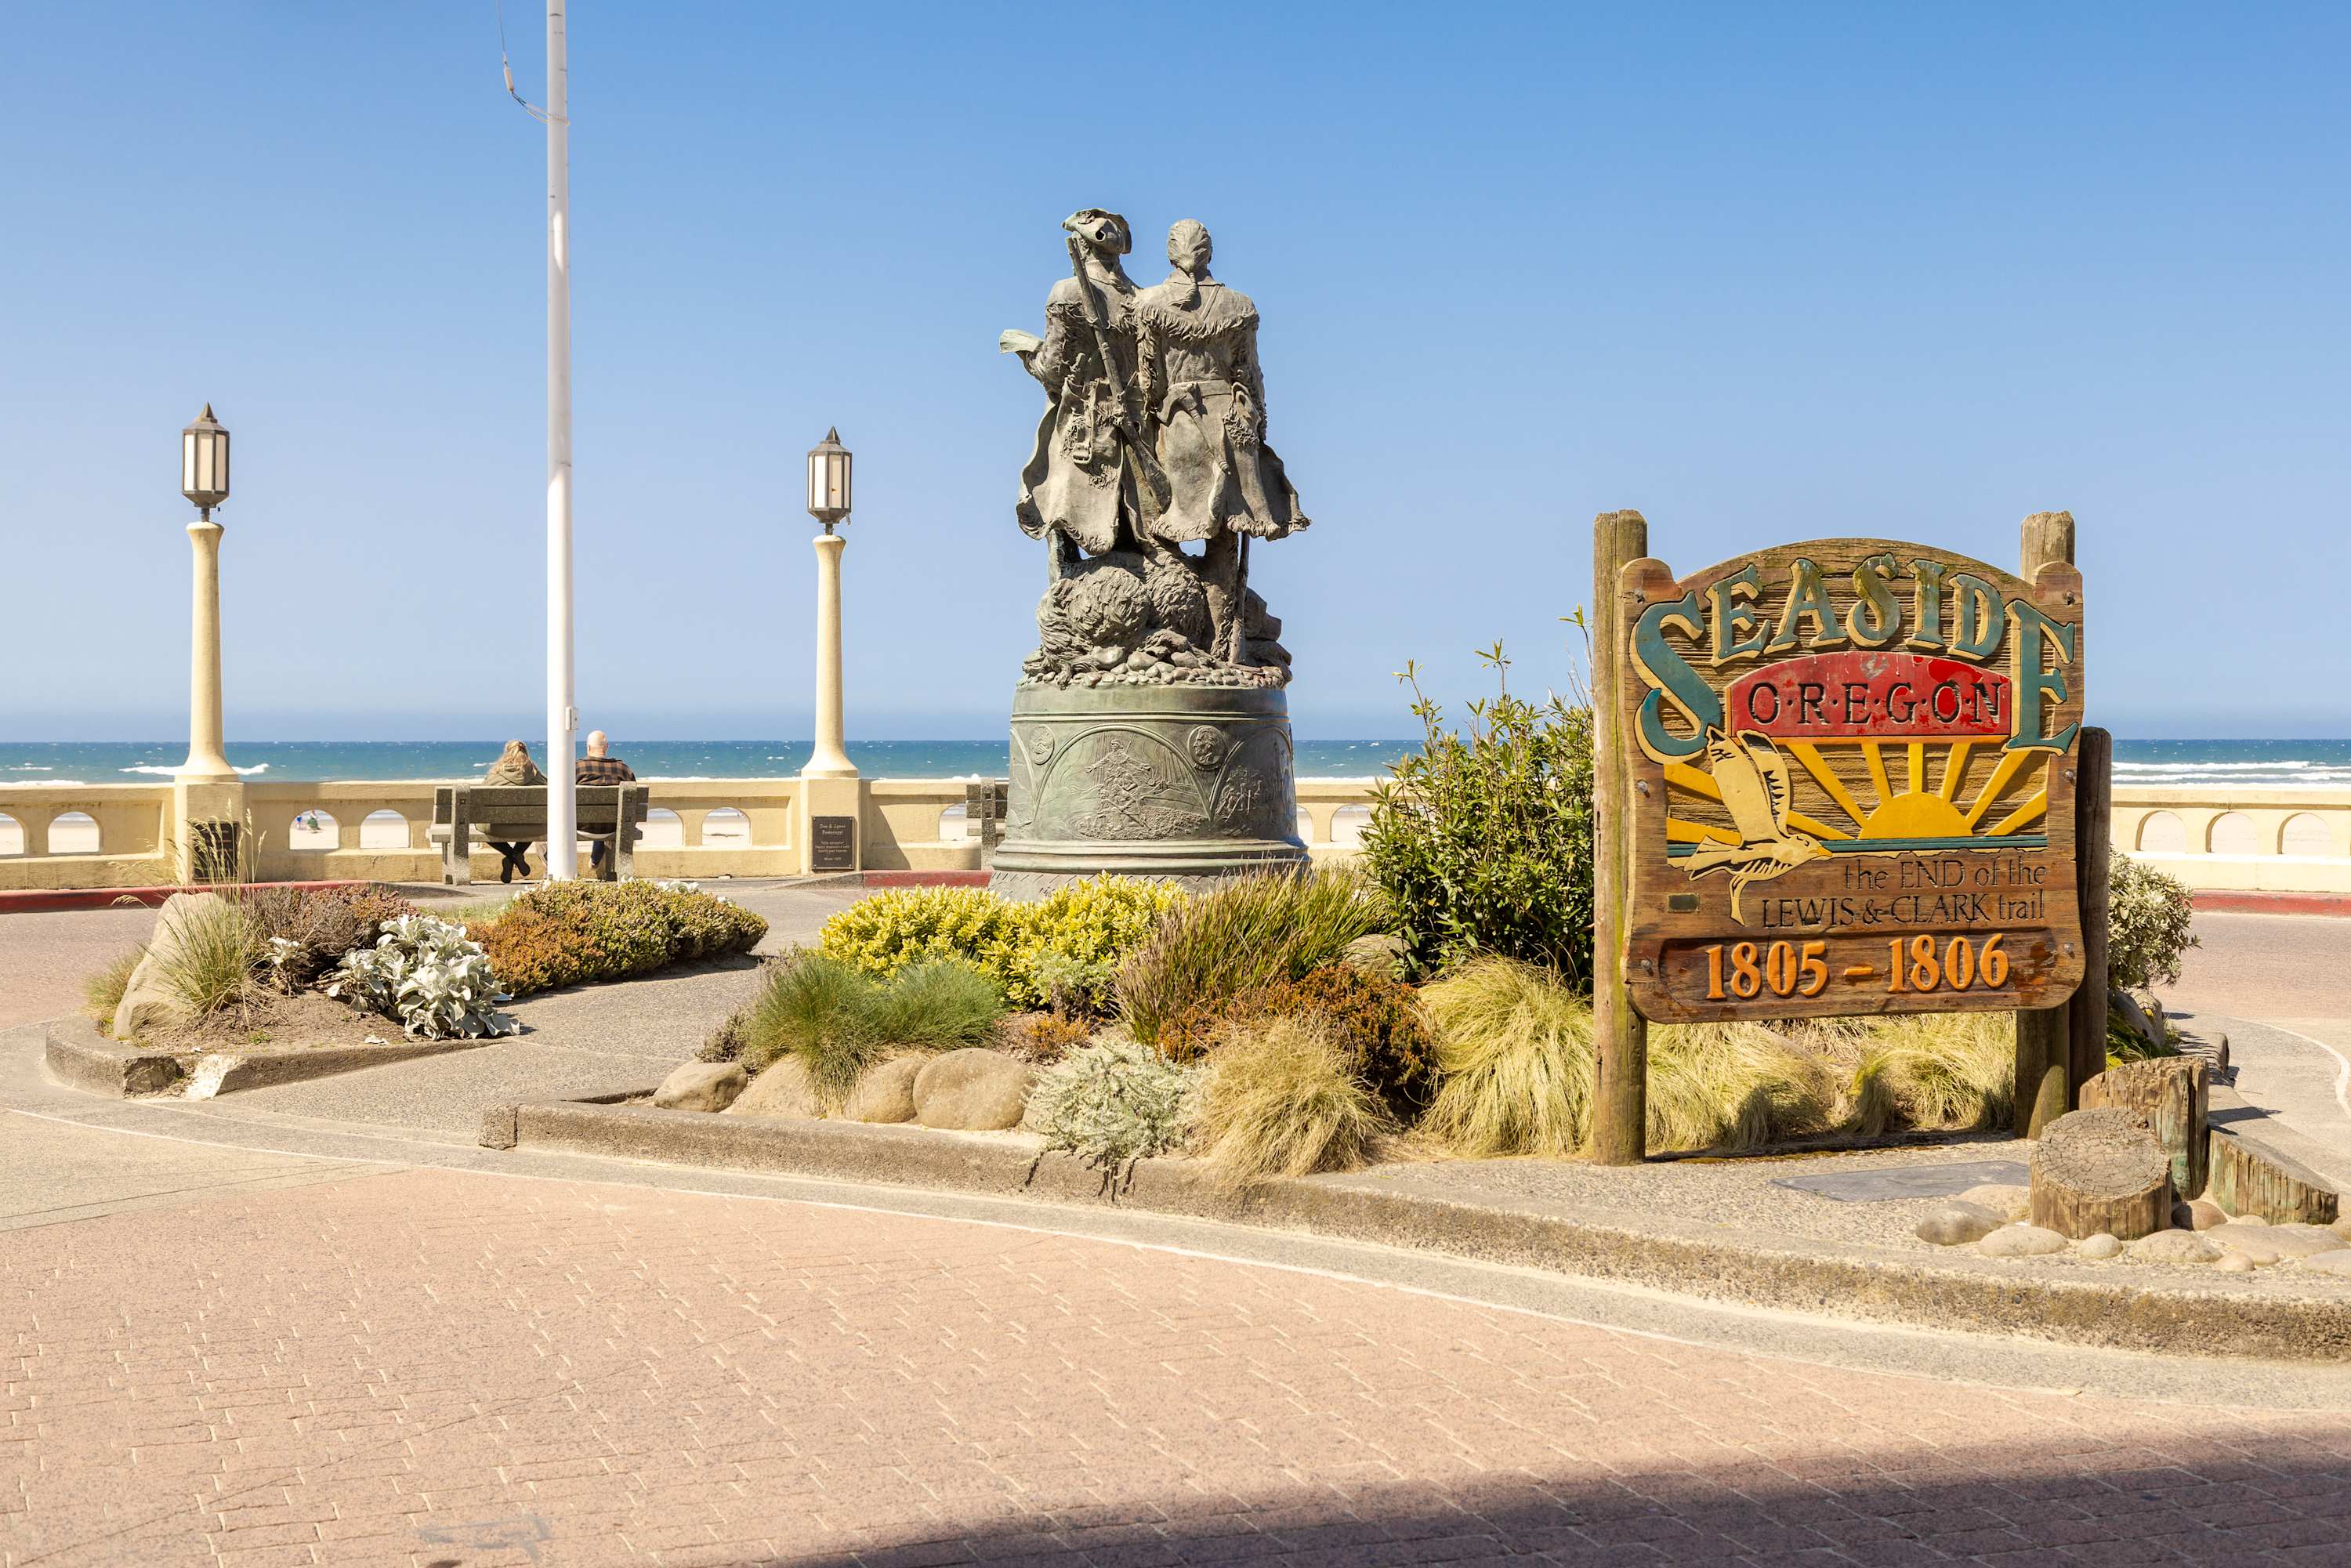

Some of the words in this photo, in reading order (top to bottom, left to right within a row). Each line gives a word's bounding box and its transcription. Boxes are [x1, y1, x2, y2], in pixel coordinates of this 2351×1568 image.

[1630, 552, 2080, 762] SEASIDE
[1844, 859, 1889, 890] the
[1900, 860, 1966, 889] END
[1974, 857, 2001, 887] of
[2009, 855, 2048, 886] the
[1762, 897, 1856, 928] LEWIS
[1863, 898, 1882, 925] &
[1890, 893, 1991, 923] CLARK
[1998, 888, 2045, 921] trail
[1704, 940, 1829, 1000] 1805
[1887, 932, 2010, 994] 1806
